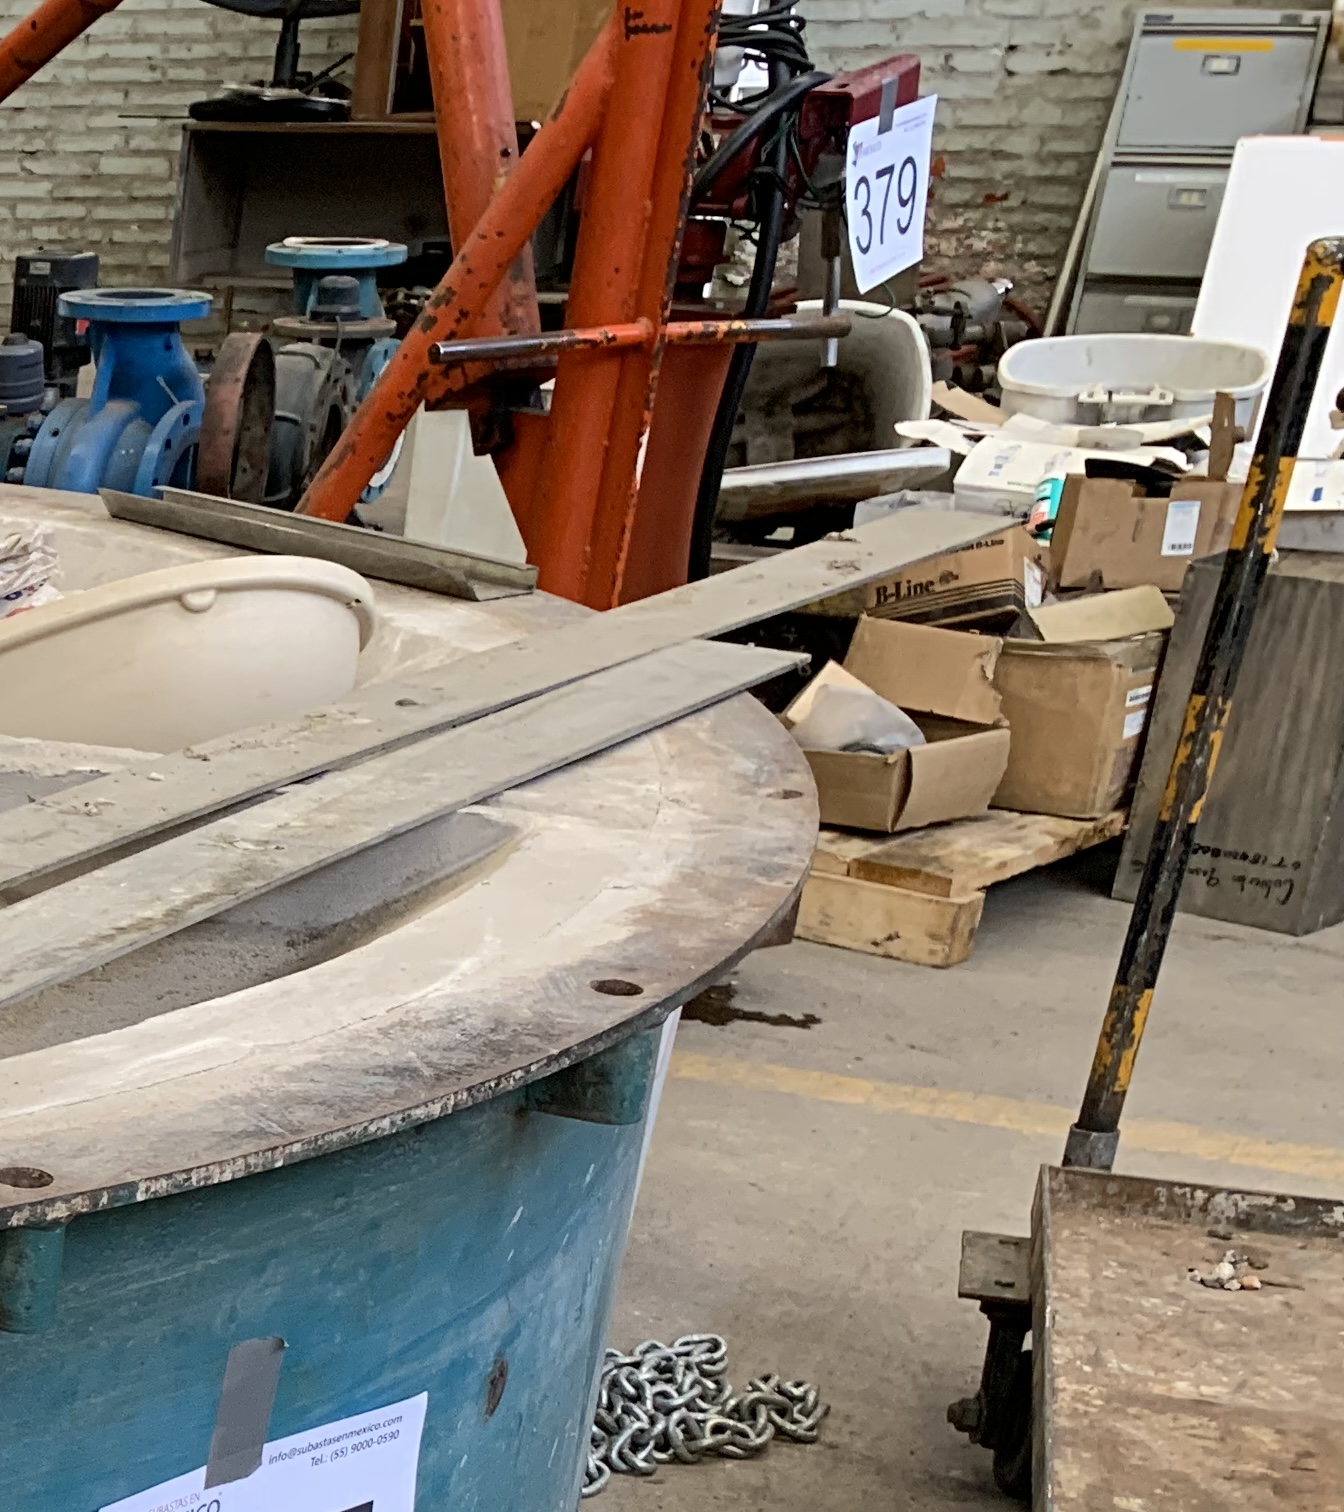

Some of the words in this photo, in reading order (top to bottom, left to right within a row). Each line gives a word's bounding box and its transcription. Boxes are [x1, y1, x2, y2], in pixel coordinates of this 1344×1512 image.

[854, 155, 917, 255] 379
[874, 578, 937, 606] B-Line
[268, 1414, 403, 1466] info@subastasenmexico.com
[330, 1446, 348, 1464] (55)
[350, 1429, 400, 1454] 9000-0590
[188, 1492, 201, 1506] EN
